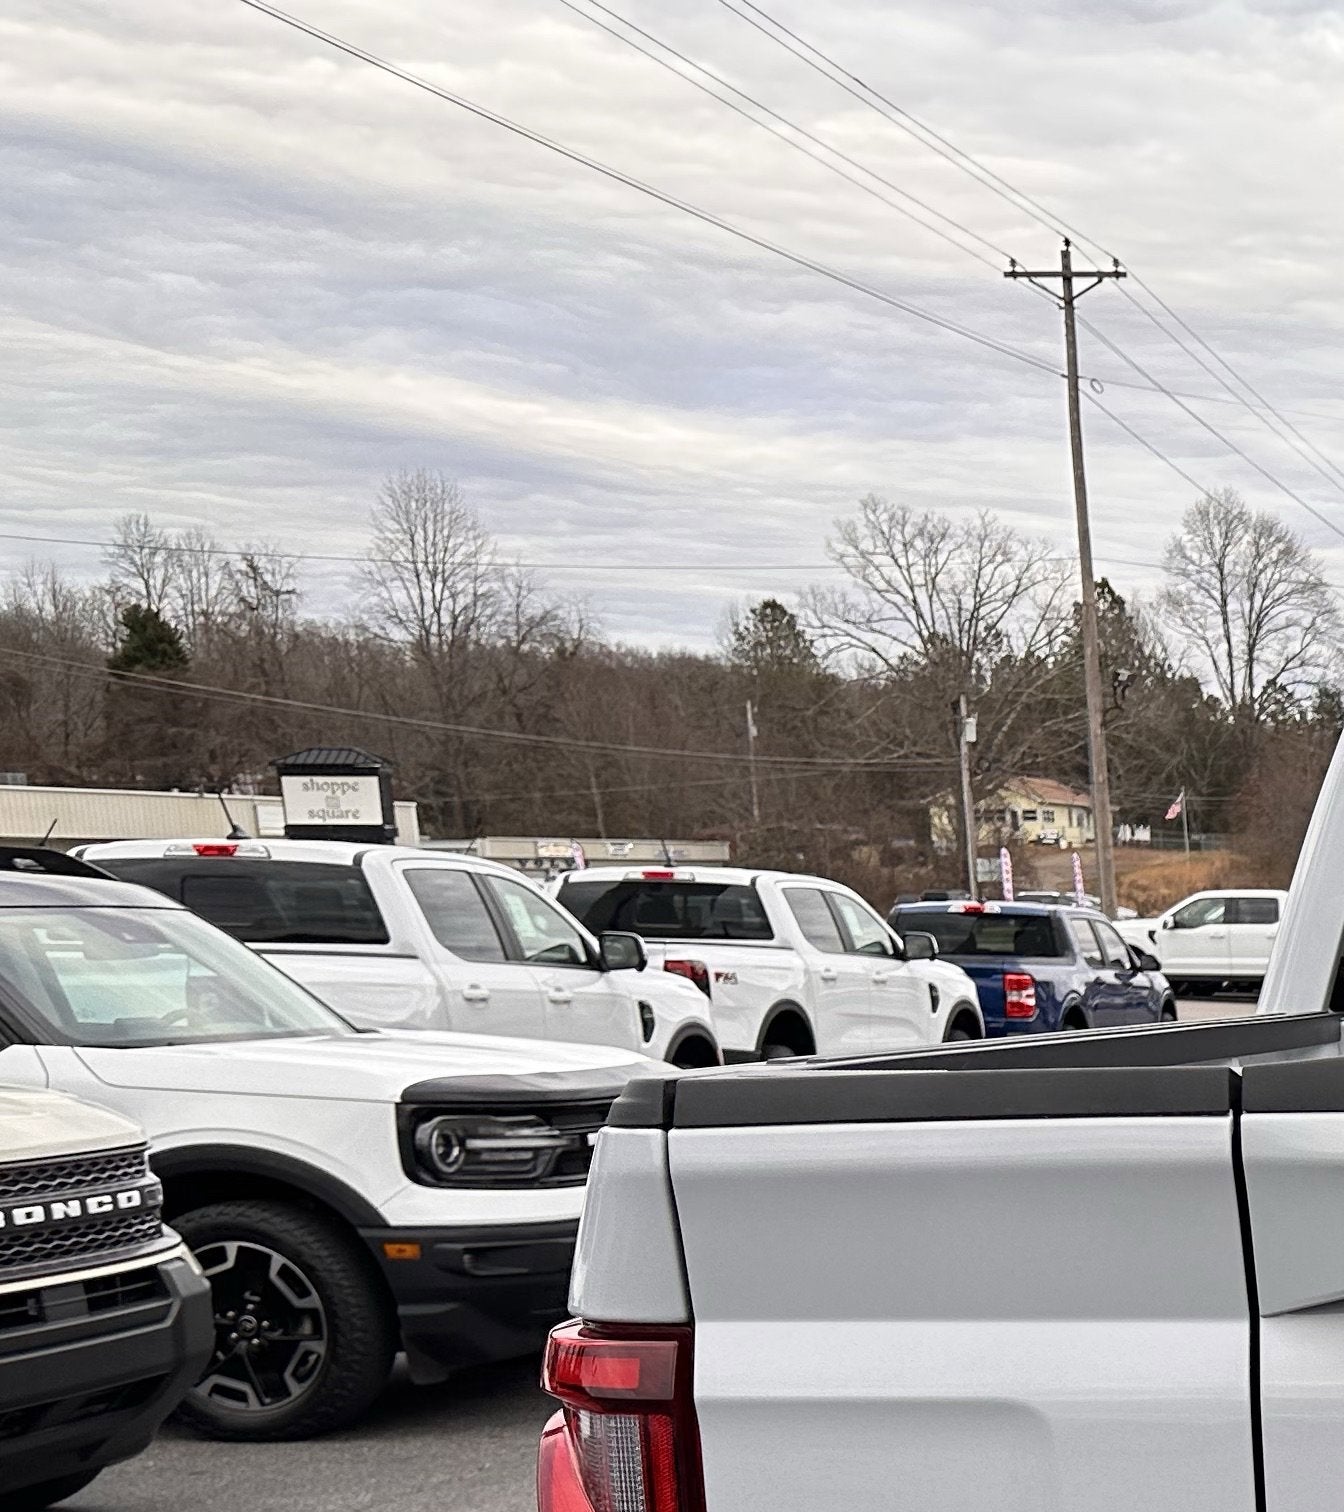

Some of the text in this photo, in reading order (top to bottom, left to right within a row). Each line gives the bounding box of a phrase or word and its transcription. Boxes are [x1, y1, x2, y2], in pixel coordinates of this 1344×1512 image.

[302, 778, 360, 795] shoppe
[308, 808, 360, 822] square
[0, 1190, 141, 1228] ONCO
